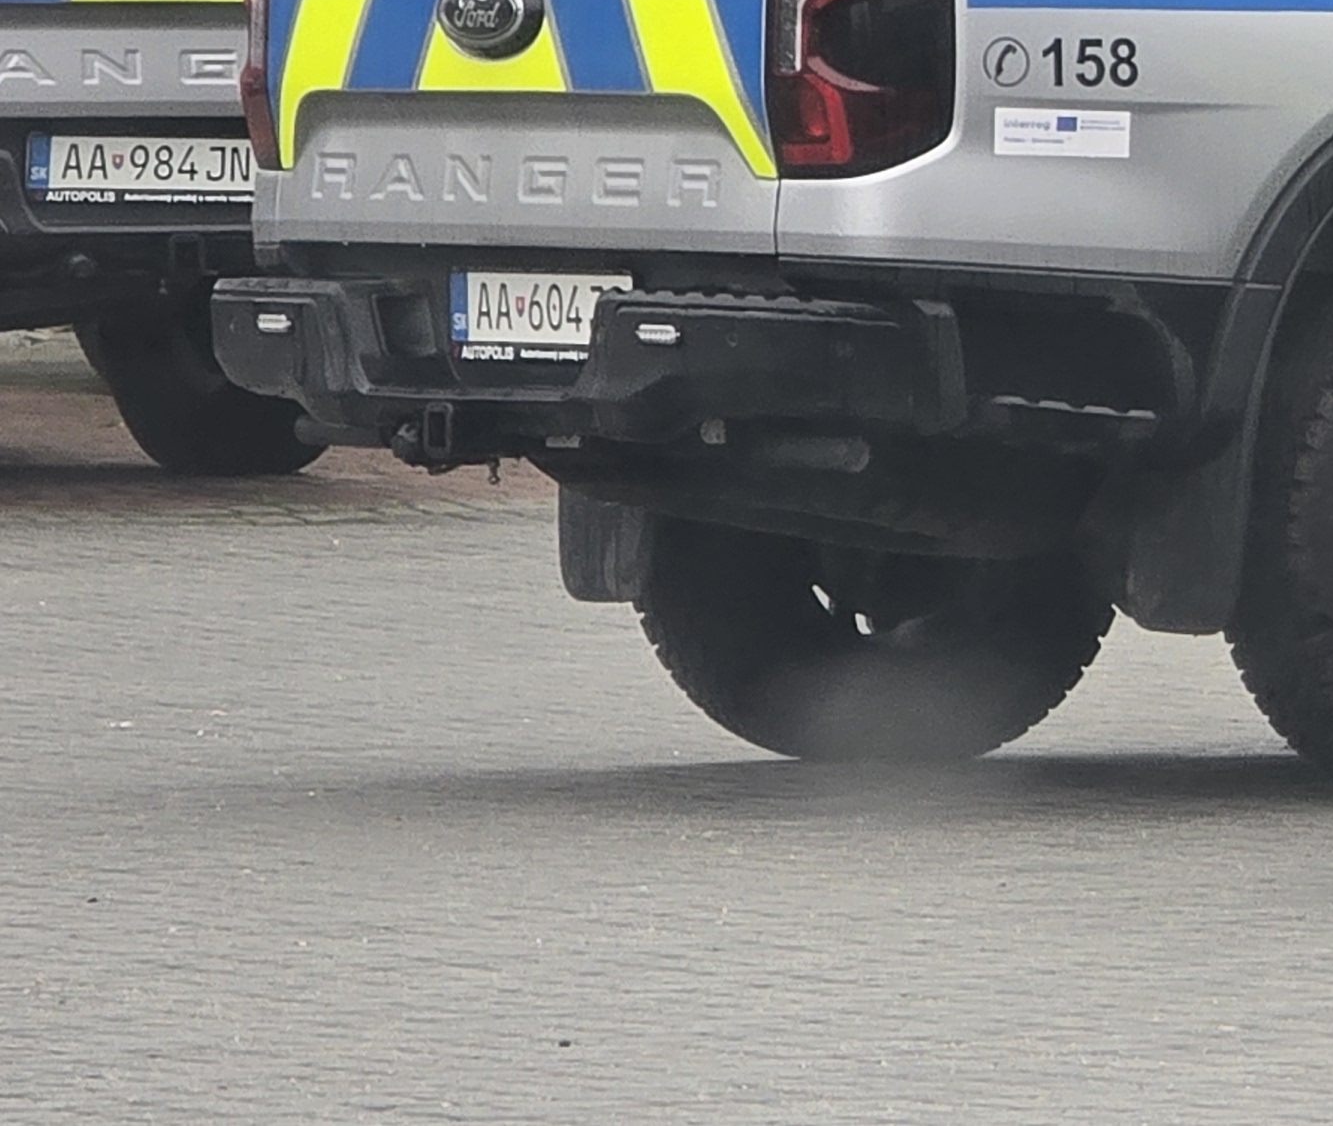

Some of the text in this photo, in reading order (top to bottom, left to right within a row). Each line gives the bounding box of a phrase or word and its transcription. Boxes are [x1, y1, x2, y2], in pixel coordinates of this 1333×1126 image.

[1041, 38, 1140, 87] 158
[311, 150, 722, 208] RANGER
[46, 190, 116, 203] AUTOPOLIS
[461, 345, 514, 360] AUTOPOLIS
